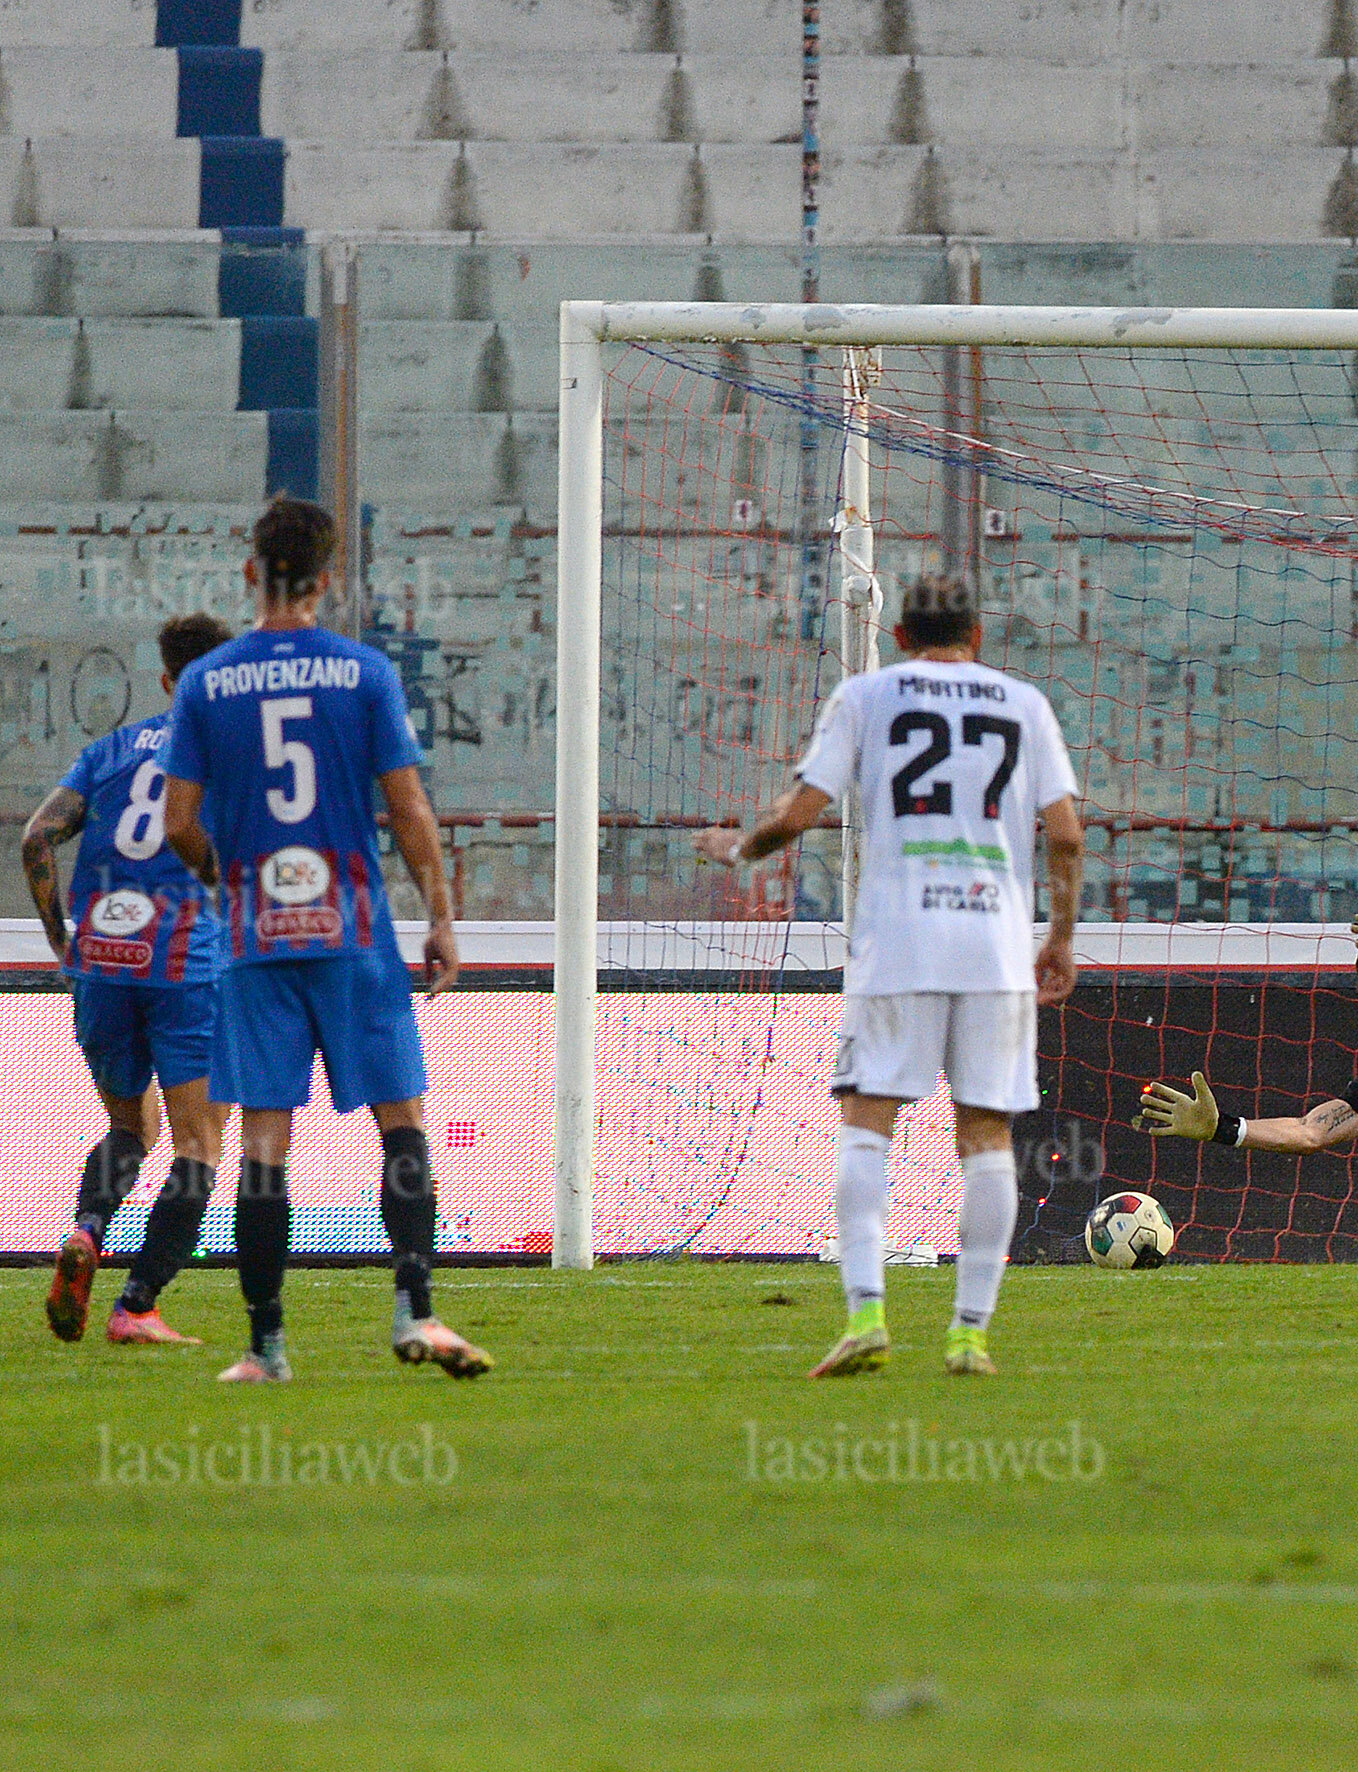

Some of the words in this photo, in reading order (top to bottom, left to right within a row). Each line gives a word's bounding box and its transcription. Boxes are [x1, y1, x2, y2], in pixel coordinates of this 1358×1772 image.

[204, 656, 361, 701] PROVENZANO
[898, 675, 1007, 703] MARTINO
[114, 757, 167, 862] 8
[260, 697, 317, 824] 5
[889, 711, 1021, 820] 27
